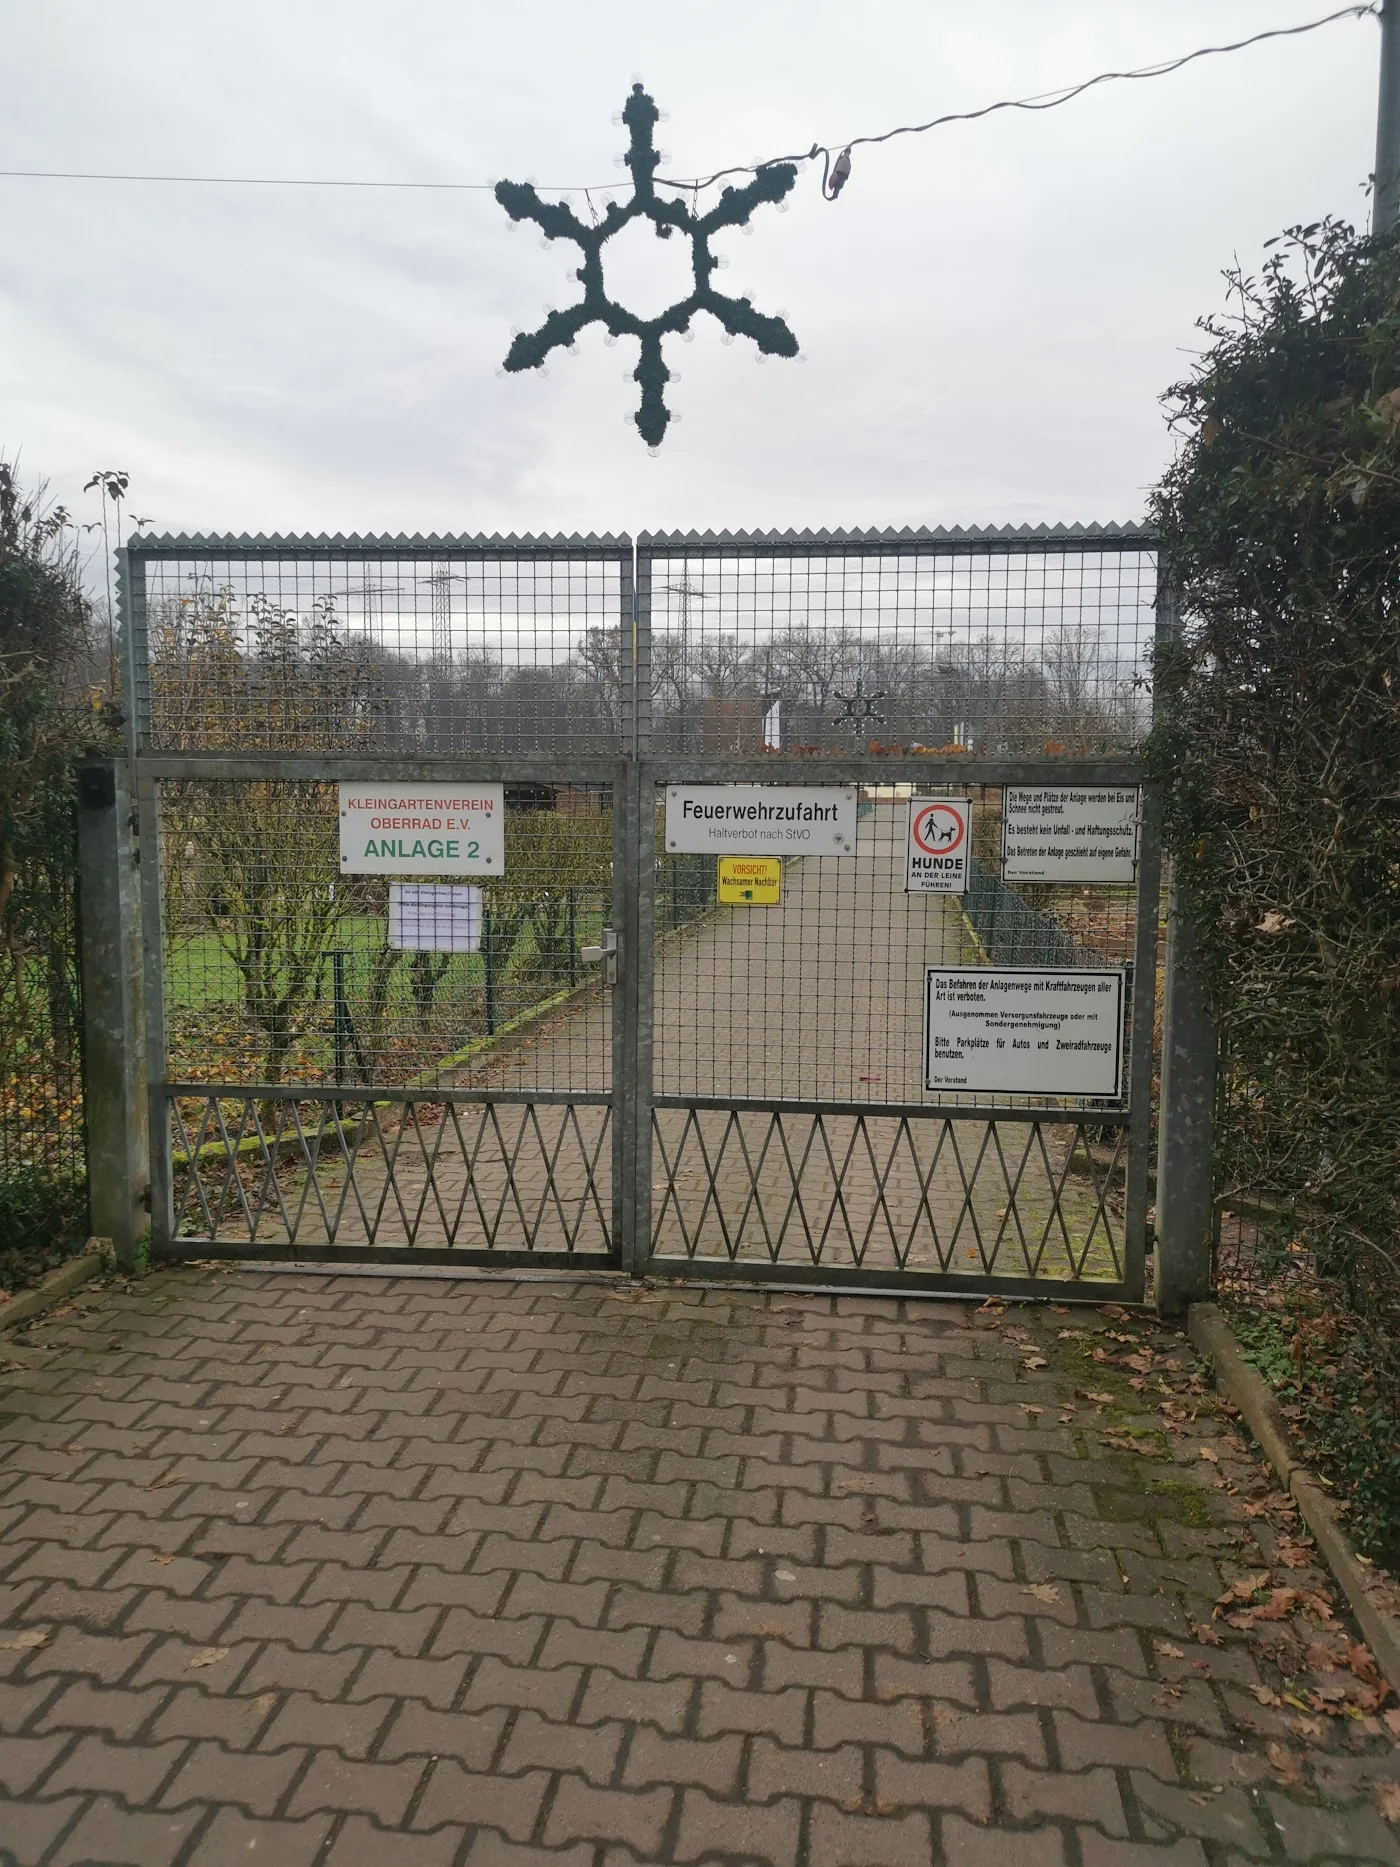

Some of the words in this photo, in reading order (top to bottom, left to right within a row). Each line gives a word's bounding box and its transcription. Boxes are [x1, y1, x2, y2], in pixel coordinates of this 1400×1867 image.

[348, 799, 493, 810] KLEINGARTENVEREIN
[1009, 791, 1017, 802] Die
[1018, 791, 1032, 804] Wege
[1033, 792, 1042, 802] und
[1043, 791, 1059, 802] Plätze
[1060, 792, 1068, 802] der
[1069, 791, 1086, 805] Anlage
[1088, 792, 1106, 803] werden
[1125, 792, 1135, 803] und
[683, 800, 838, 821] Feuerwehrzufahrt
[1008, 803, 1027, 814] Schnee
[1028, 803, 1041, 813] nicht
[1041, 804, 1064, 816] gestreut.
[371, 817, 442, 830] OBERRAD
[446, 818, 471, 830] E.V.
[708, 827, 758, 839] Haltverbot
[760, 828, 783, 839] nach
[785, 828, 811, 840] StVO
[1008, 824, 1015, 835] Es
[1016, 824, 1038, 835] besteht
[1040, 824, 1052, 835] kein
[1053, 824, 1070, 835] Unfall
[1075, 825, 1085, 835] und
[1087, 824, 1133, 838] Haftungsschutz.
[364, 839, 459, 858] ANLAGE
[467, 841, 480, 858] 2
[1006, 845, 1016, 856] Das
[1017, 845, 1037, 856] Betreten
[1039, 846, 1047, 856] der
[1047, 846, 1064, 859] Anlage
[1065, 846, 1088, 859] geschieht
[1089, 846, 1097, 857] auf
[1098, 847, 1114, 860] eigene
[1115, 847, 1132, 857] Gefahr.
[732, 864, 767, 875] VORSICHT!
[912, 857, 963, 870] HUNDE
[721, 876, 753, 886] Wachsamer
[754, 876, 777, 887] Nachbar
[921, 880, 952, 888] FÜHREN!
[935, 978, 947, 989] Das
[949, 978, 977, 989] Befahren
[978, 979, 989, 990] der
[990, 979, 1032, 993] Anlagenwege
[1033, 980, 1044, 991] mit
[1045, 980, 1096, 994] Kraftfahrzeugen
[1097, 981, 1112, 992] aller
[935, 990, 946, 1001] Art
[947, 990, 955, 1001] ist
[956, 992, 986, 1002] verboten.
[949, 1010, 998, 1018] (Ausgenommen
[985, 1020, 1061, 1030] Sondergenehmigung)
[935, 1036, 950, 1047] Bitte
[956, 1036, 989, 1050] Parkplätze
[996, 1037, 1005, 1048] für
[1012, 1038, 1030, 1049] Autos
[1037, 1039, 1049, 1050] und
[1056, 1039, 1112, 1054] Zweiradfahrzeuge
[935, 1048, 964, 1059] benutzen.
[934, 1075, 943, 1083] Der
[944, 1076, 967, 1084] Vorstand
